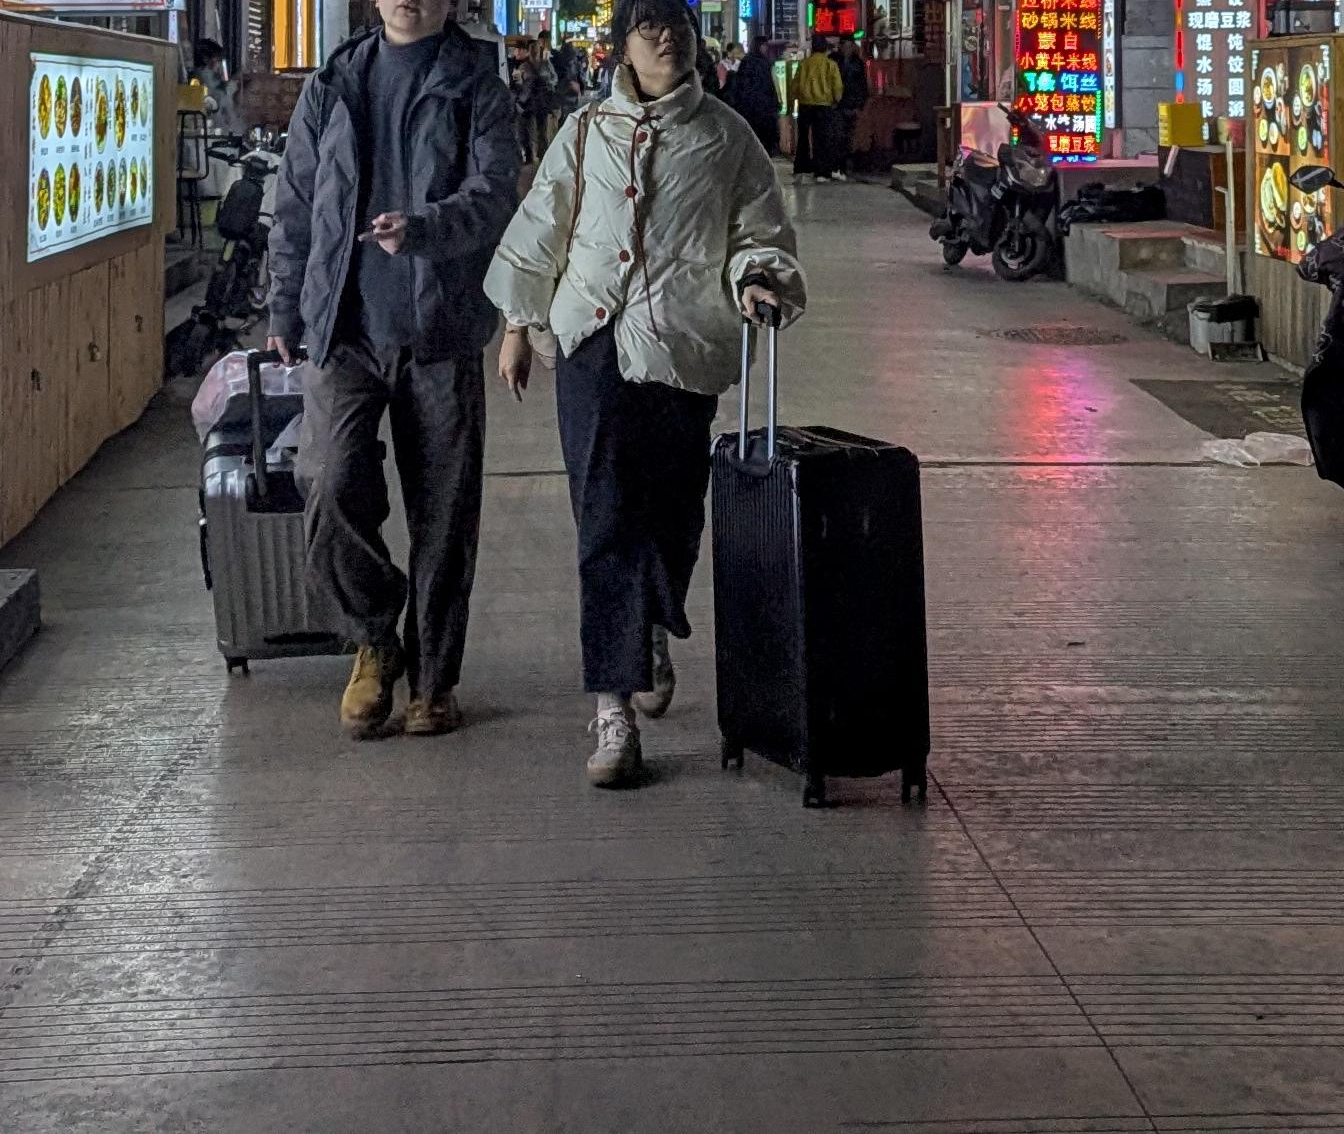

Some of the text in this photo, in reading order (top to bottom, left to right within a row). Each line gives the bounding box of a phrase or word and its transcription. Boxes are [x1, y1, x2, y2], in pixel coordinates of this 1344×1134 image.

[1022, 12, 1097, 29] 砂锅米线
[1188, 12, 1251, 29] 现磨豆浆
[1038, 32, 1077, 50] 蒙自
[1196, 34, 1244, 51] 馄饨
[1020, 52, 1097, 71] 小黄牛米线
[1196, 56, 1244, 73] 水饺
[1196, 78, 1244, 96] 汤圆
